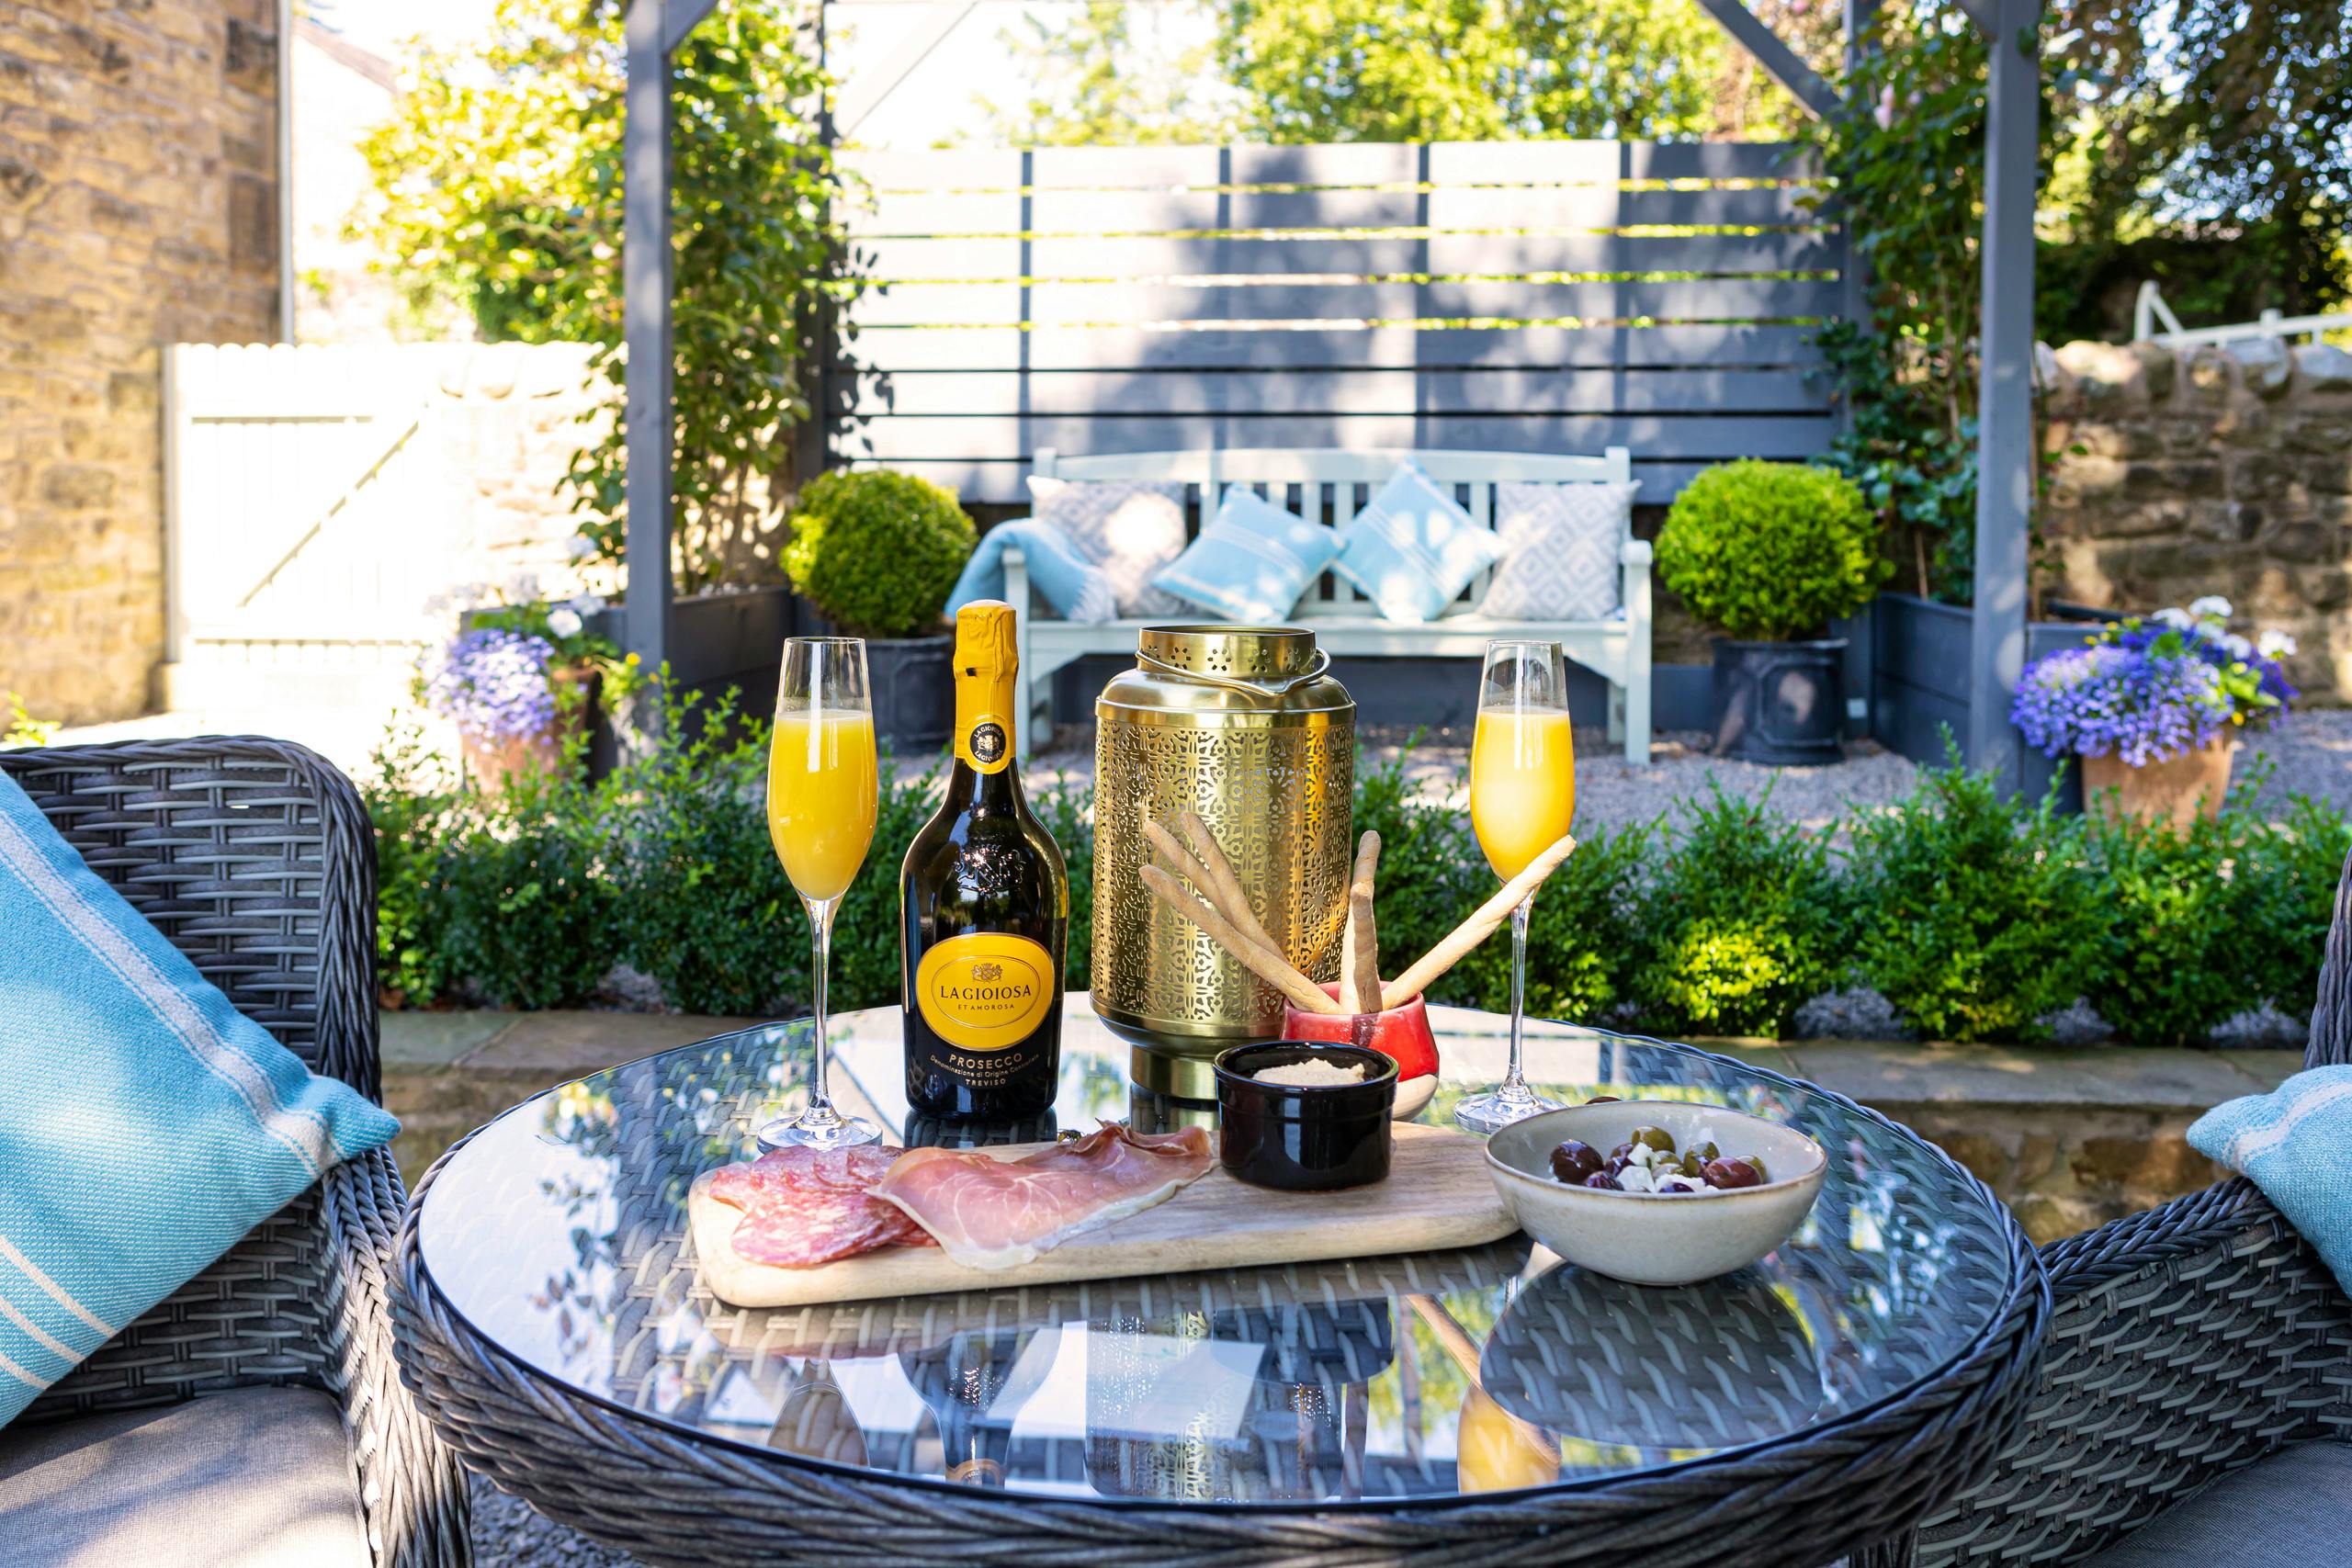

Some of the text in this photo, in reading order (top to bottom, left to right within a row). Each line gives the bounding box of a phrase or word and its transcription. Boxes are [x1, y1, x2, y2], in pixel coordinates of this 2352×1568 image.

[930, 1055, 974, 1077] Denominazione
[949, 1053, 1022, 1069] PROSECCO
[966, 1078, 1006, 1087] TREVISO
